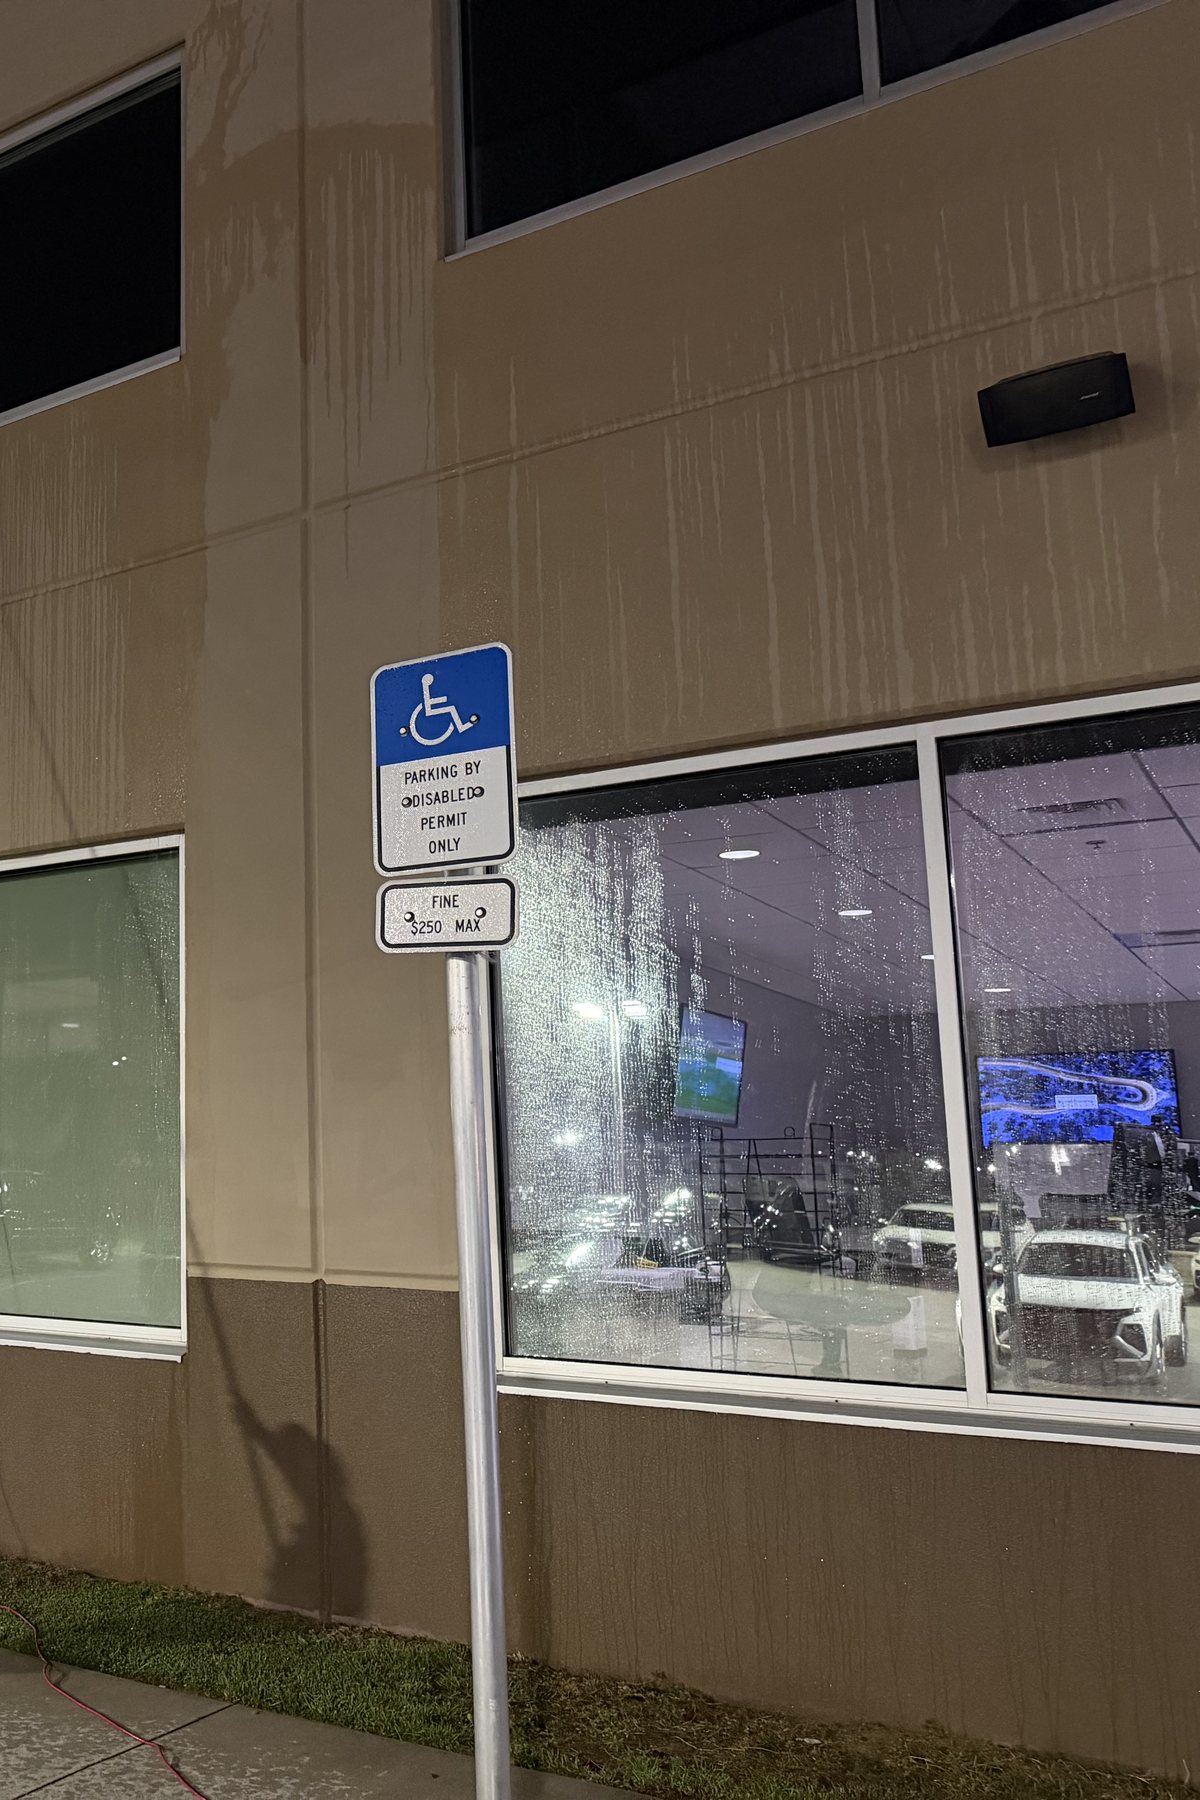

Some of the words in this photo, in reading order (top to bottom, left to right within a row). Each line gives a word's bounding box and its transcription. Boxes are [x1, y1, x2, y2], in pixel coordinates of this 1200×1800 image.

[405, 764, 458, 785] PARKING
[465, 760, 481, 775] BY
[412, 786, 475, 808] DISABLED
[421, 812, 467, 831] PERMIT
[429, 837, 460, 854] ONLY
[432, 894, 459, 908] FINE
[411, 920, 442, 936] $250
[456, 918, 481, 932] MAX
